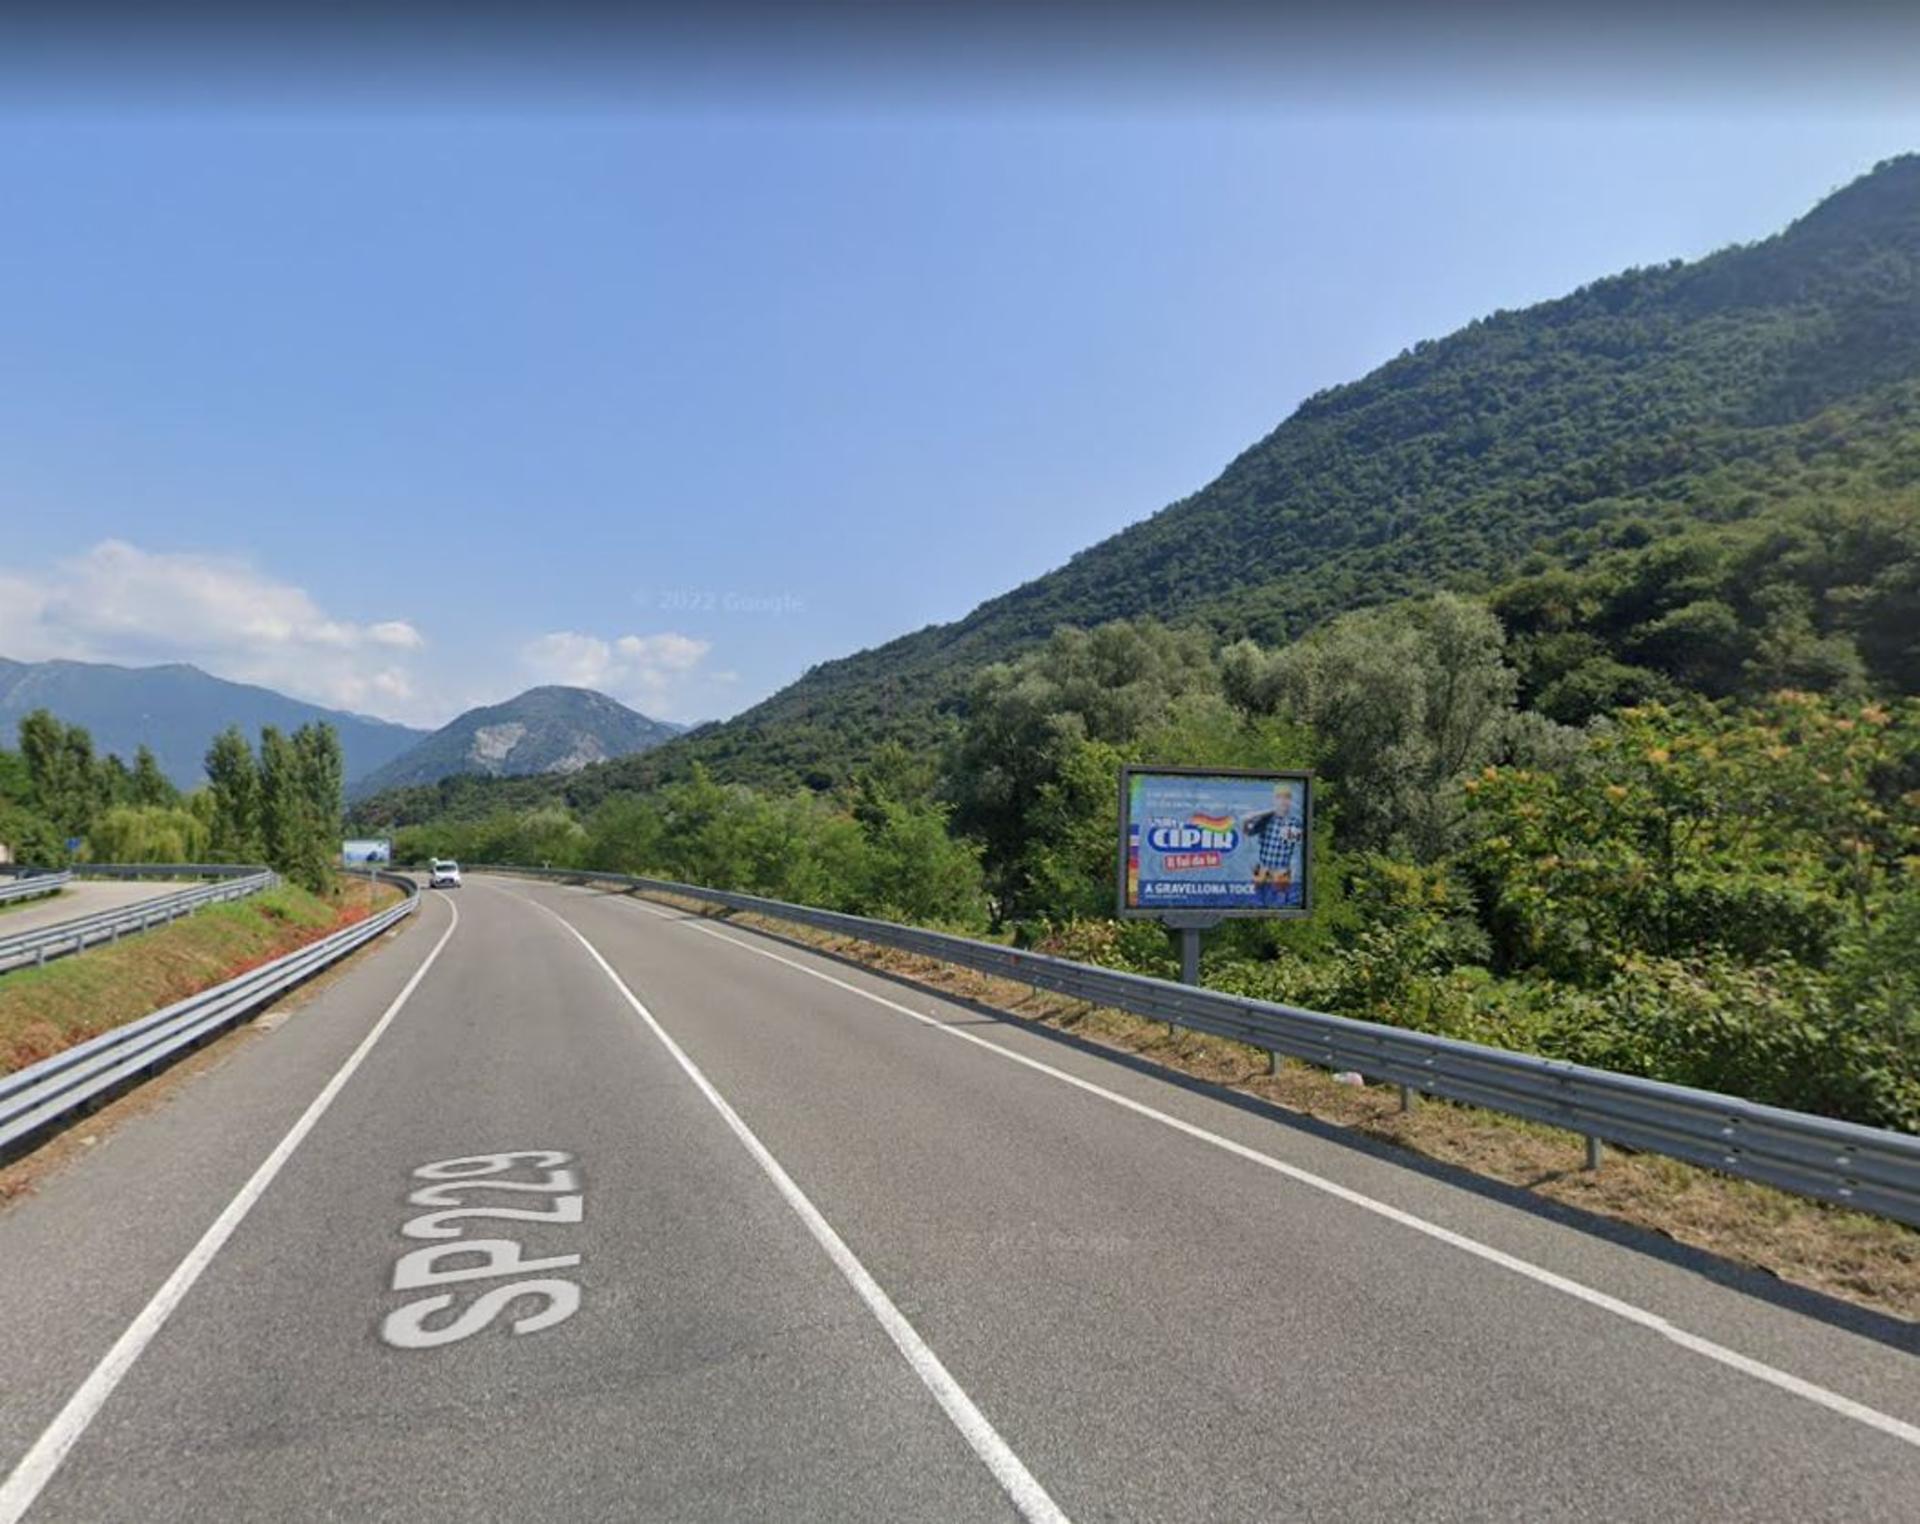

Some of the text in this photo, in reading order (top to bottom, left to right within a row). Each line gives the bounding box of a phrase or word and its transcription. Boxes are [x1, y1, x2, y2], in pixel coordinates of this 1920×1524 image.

[1145, 884, 1152, 893] A
[1155, 884, 1227, 894] GRAVELLONA
[383, 1150, 583, 1349] SP229
